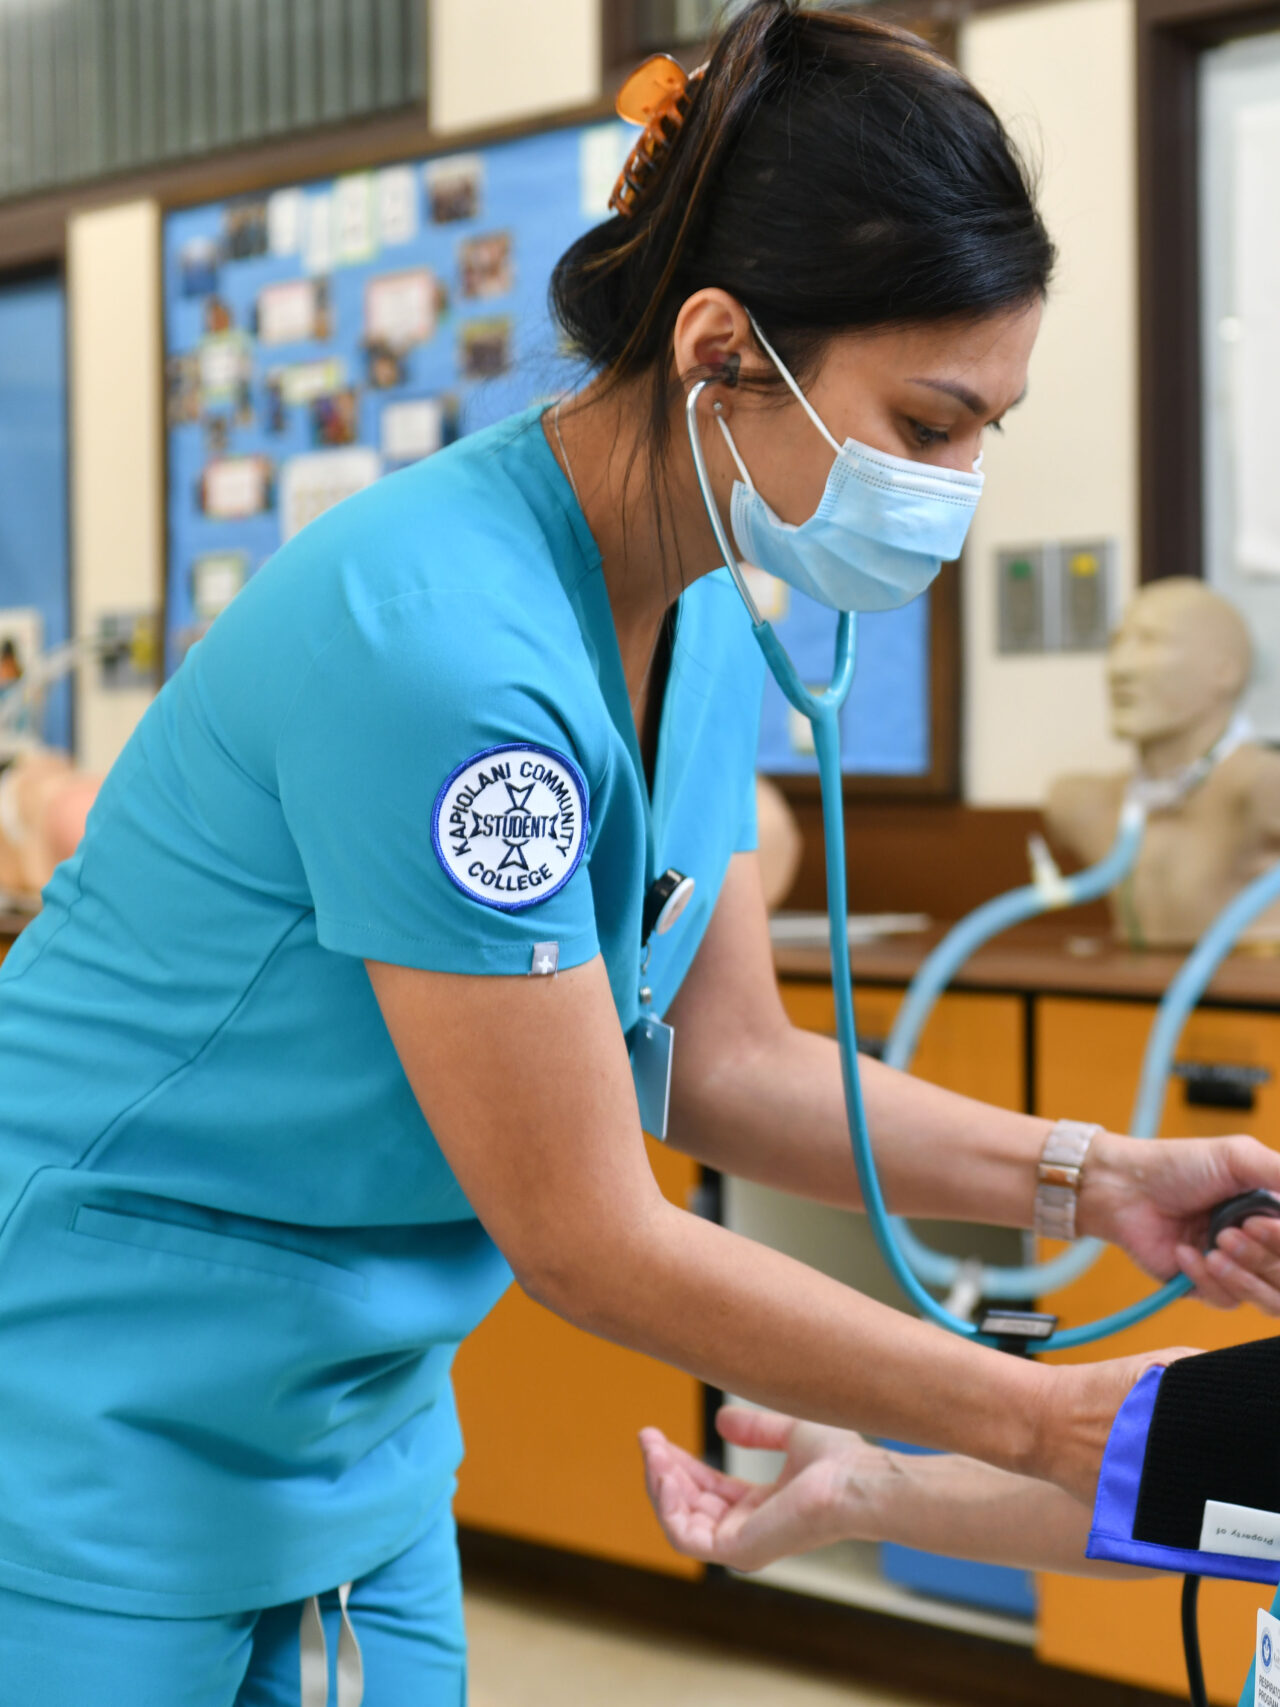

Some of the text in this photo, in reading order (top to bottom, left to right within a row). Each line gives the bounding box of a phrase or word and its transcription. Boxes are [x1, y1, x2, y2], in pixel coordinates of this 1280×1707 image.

[449, 761, 575, 858] KAPIOLANI COMMUNITY
[482, 814, 549, 838] STUDENT
[467, 861, 553, 891] COLLEGE
[1231, 1529, 1274, 1545] Property
